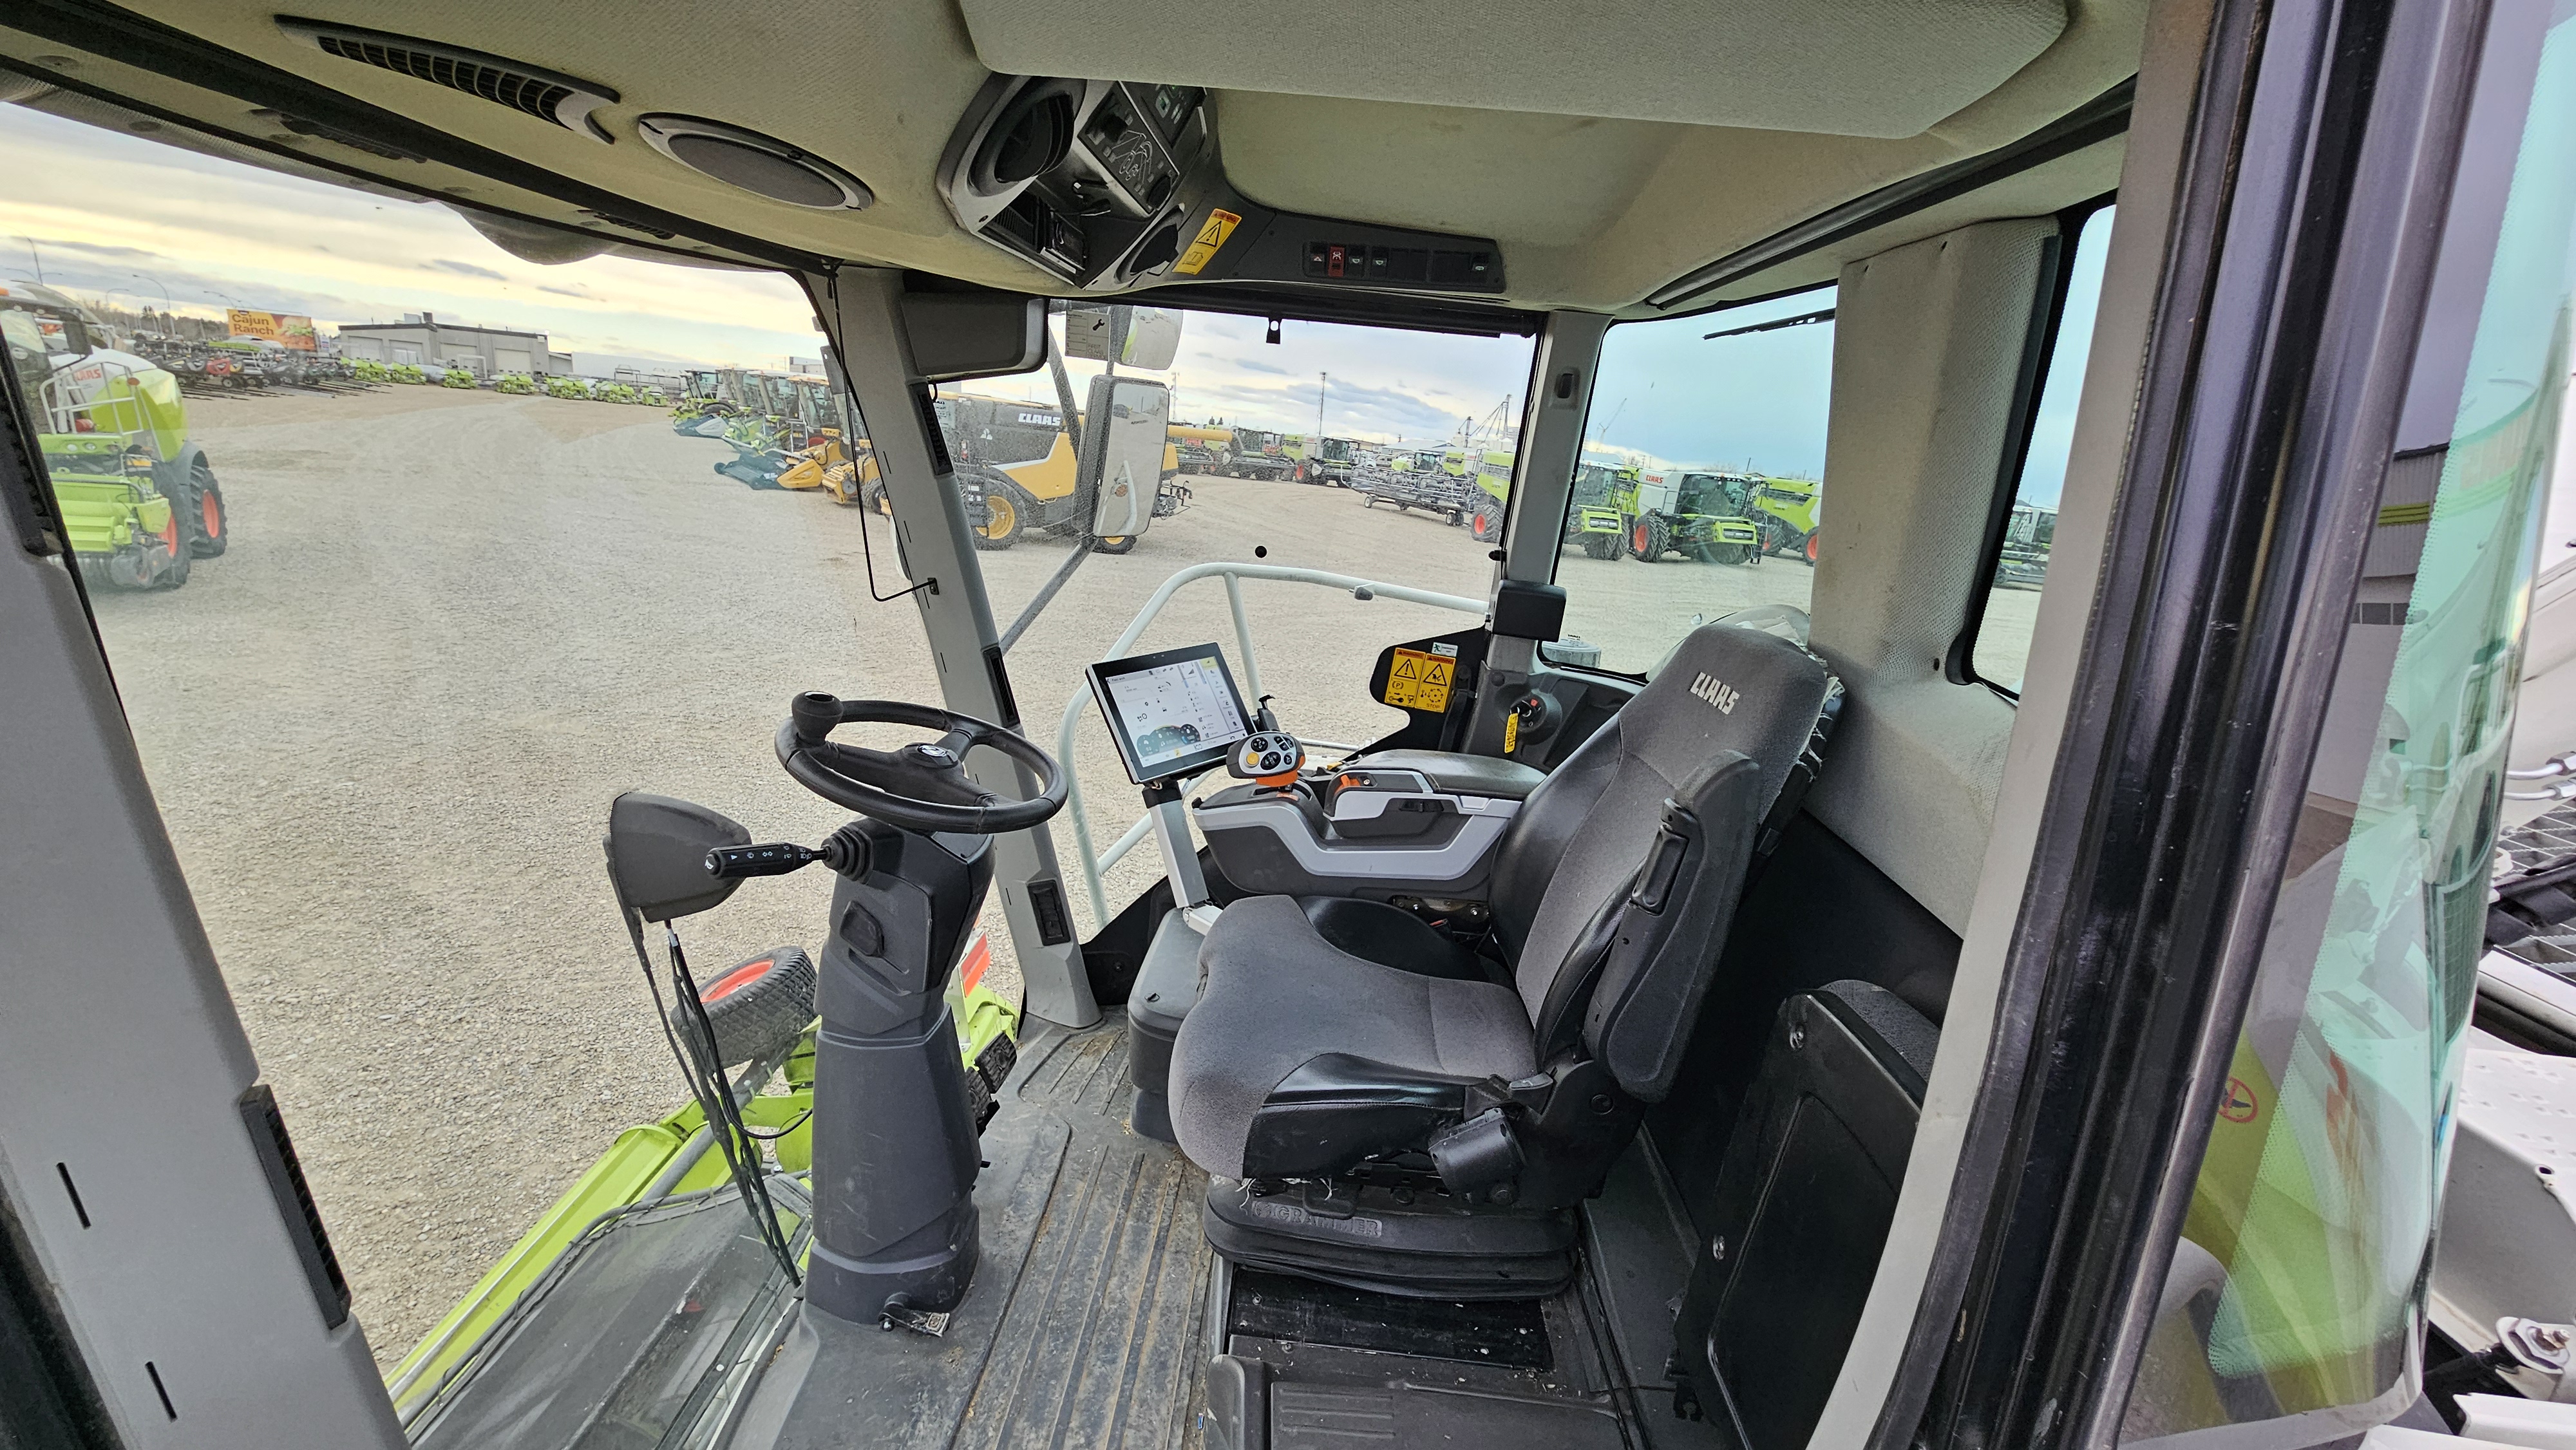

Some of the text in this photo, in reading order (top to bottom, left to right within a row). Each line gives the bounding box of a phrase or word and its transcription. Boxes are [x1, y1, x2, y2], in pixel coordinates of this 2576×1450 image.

[232, 314, 269, 326] Cajun
[233, 324, 274, 335] Ranch
[1018, 413, 1061, 426] CLAAS
[1645, 475, 1663, 484] CLAAS
[1690, 672, 1740, 715] CLAAS
